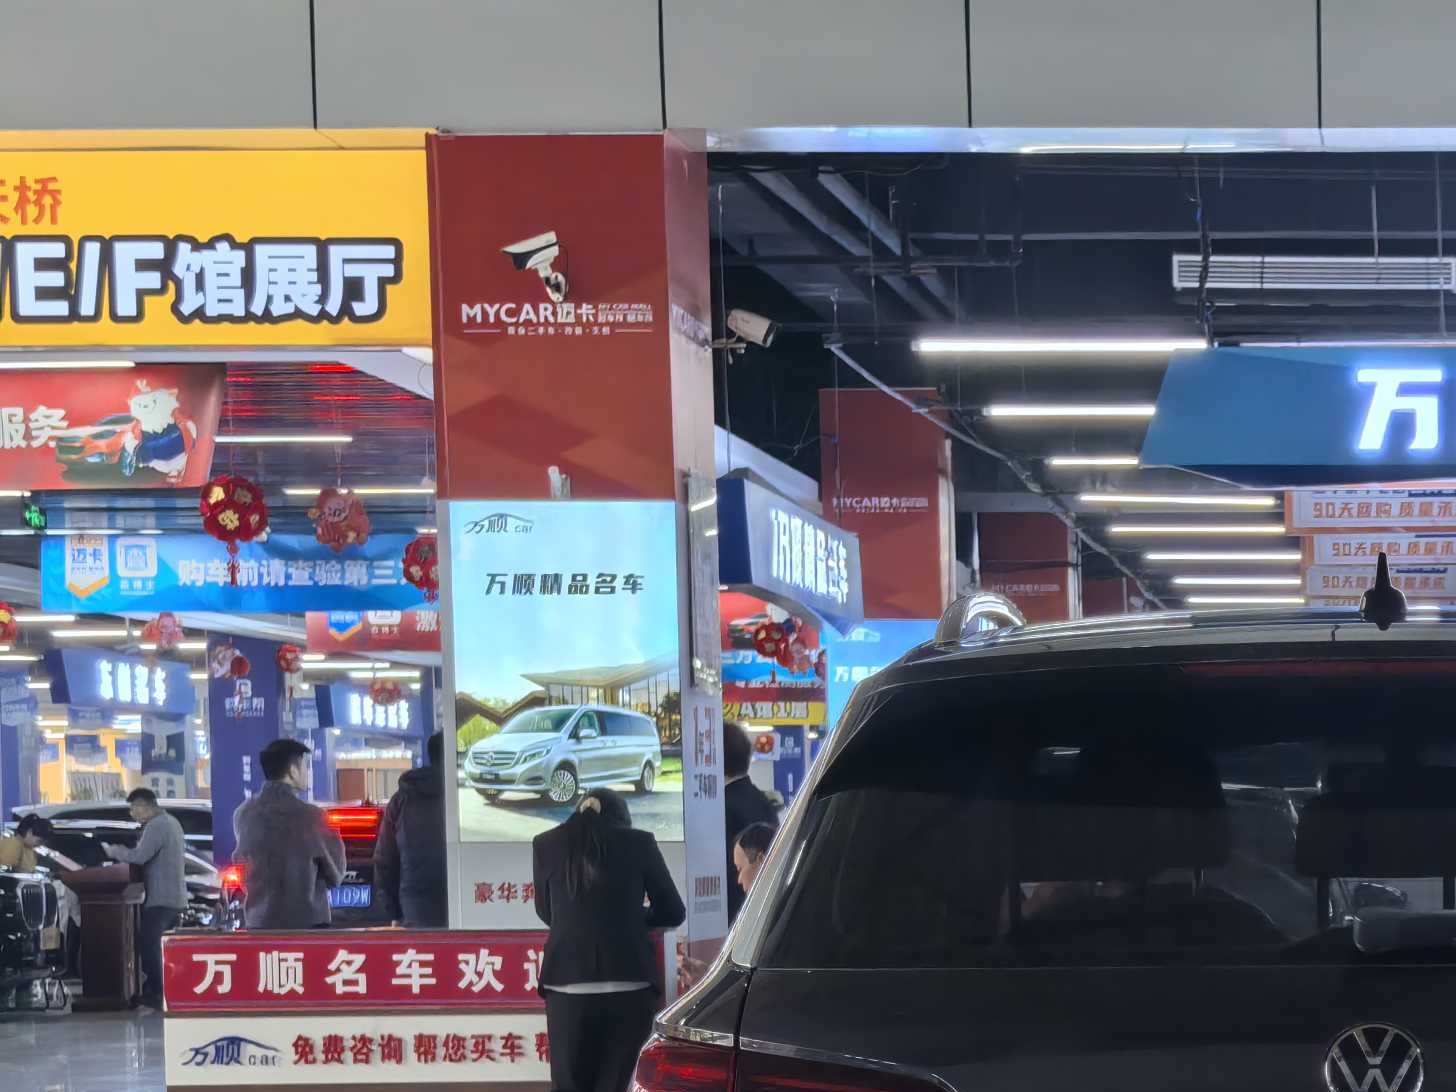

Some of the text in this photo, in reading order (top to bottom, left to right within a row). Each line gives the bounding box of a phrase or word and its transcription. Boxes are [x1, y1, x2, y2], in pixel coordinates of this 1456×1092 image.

[0, 176, 63, 226] 桥
[0, 238, 398, 320] E/F馆展厅
[177, 558, 408, 588] 购车前请查验第三
[484, 572, 645, 597] 万顺精品名车
[291, 1033, 404, 1065] 免费咨询
[413, 1032, 528, 1065] 帮您买车
